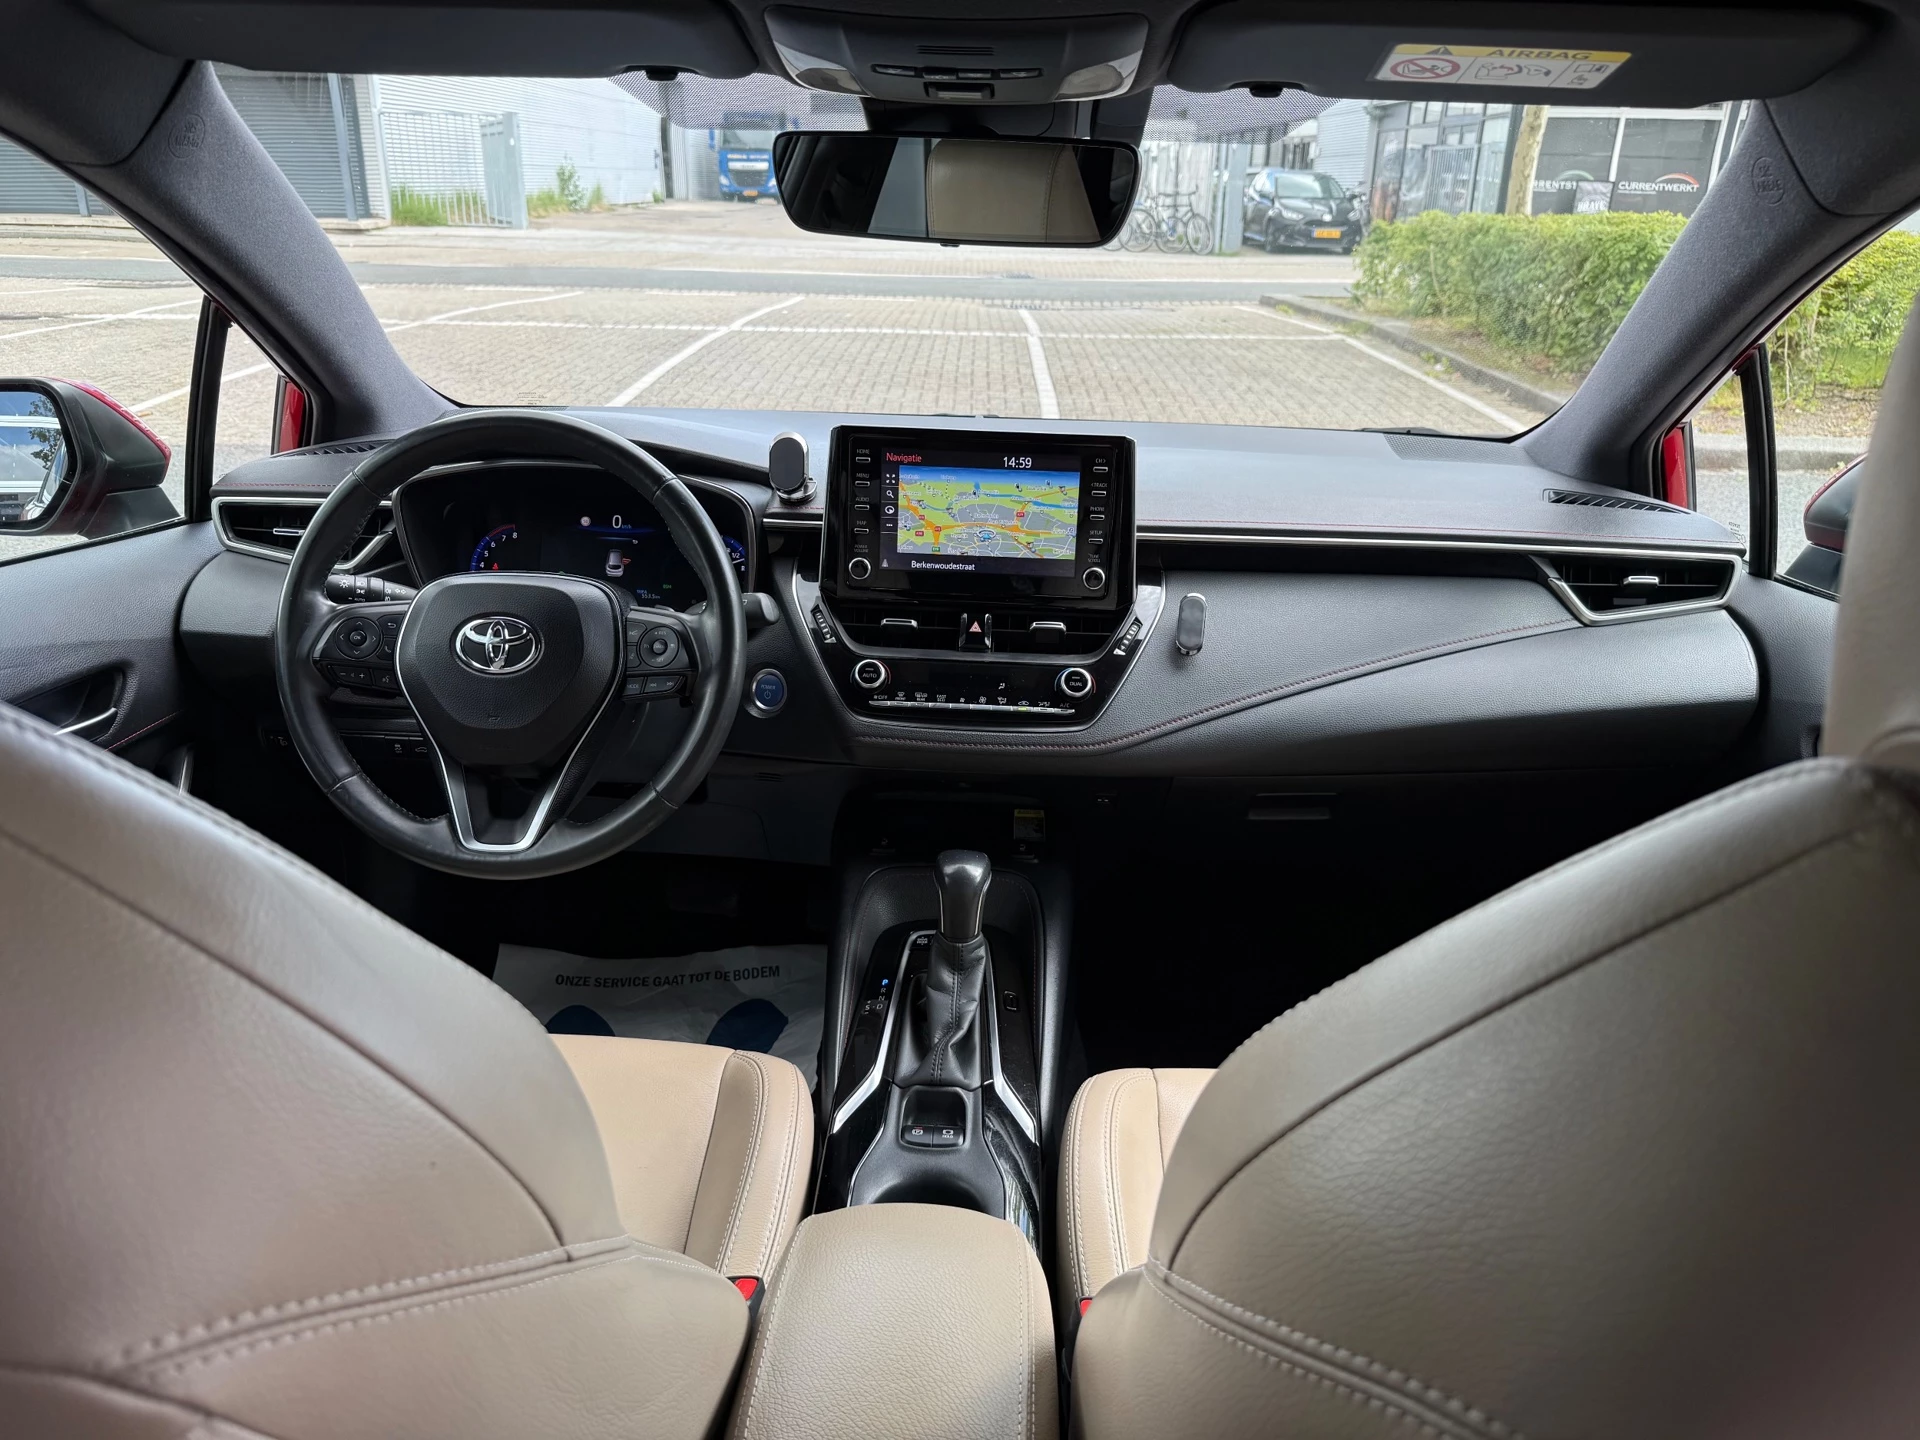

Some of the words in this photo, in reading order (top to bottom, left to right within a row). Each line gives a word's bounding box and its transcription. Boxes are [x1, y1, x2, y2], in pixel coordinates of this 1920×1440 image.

[1486, 49, 1592, 60] AIRBAG
[1618, 181, 1698, 193] CURRENTWERKT
[886, 452, 922, 463] Navigatie
[1003, 456, 1032, 468] 14:59
[612, 514, 622, 529] 0
[911, 560, 976, 571] Berkenwoudestraat
[555, 974, 592, 987] ONZE
[593, 976, 649, 988] SERVICE
[652, 974, 686, 987] GAAT
[688, 971, 711, 984] TOT
[714, 970, 731, 982] DE
[733, 965, 781, 981] BODEM
